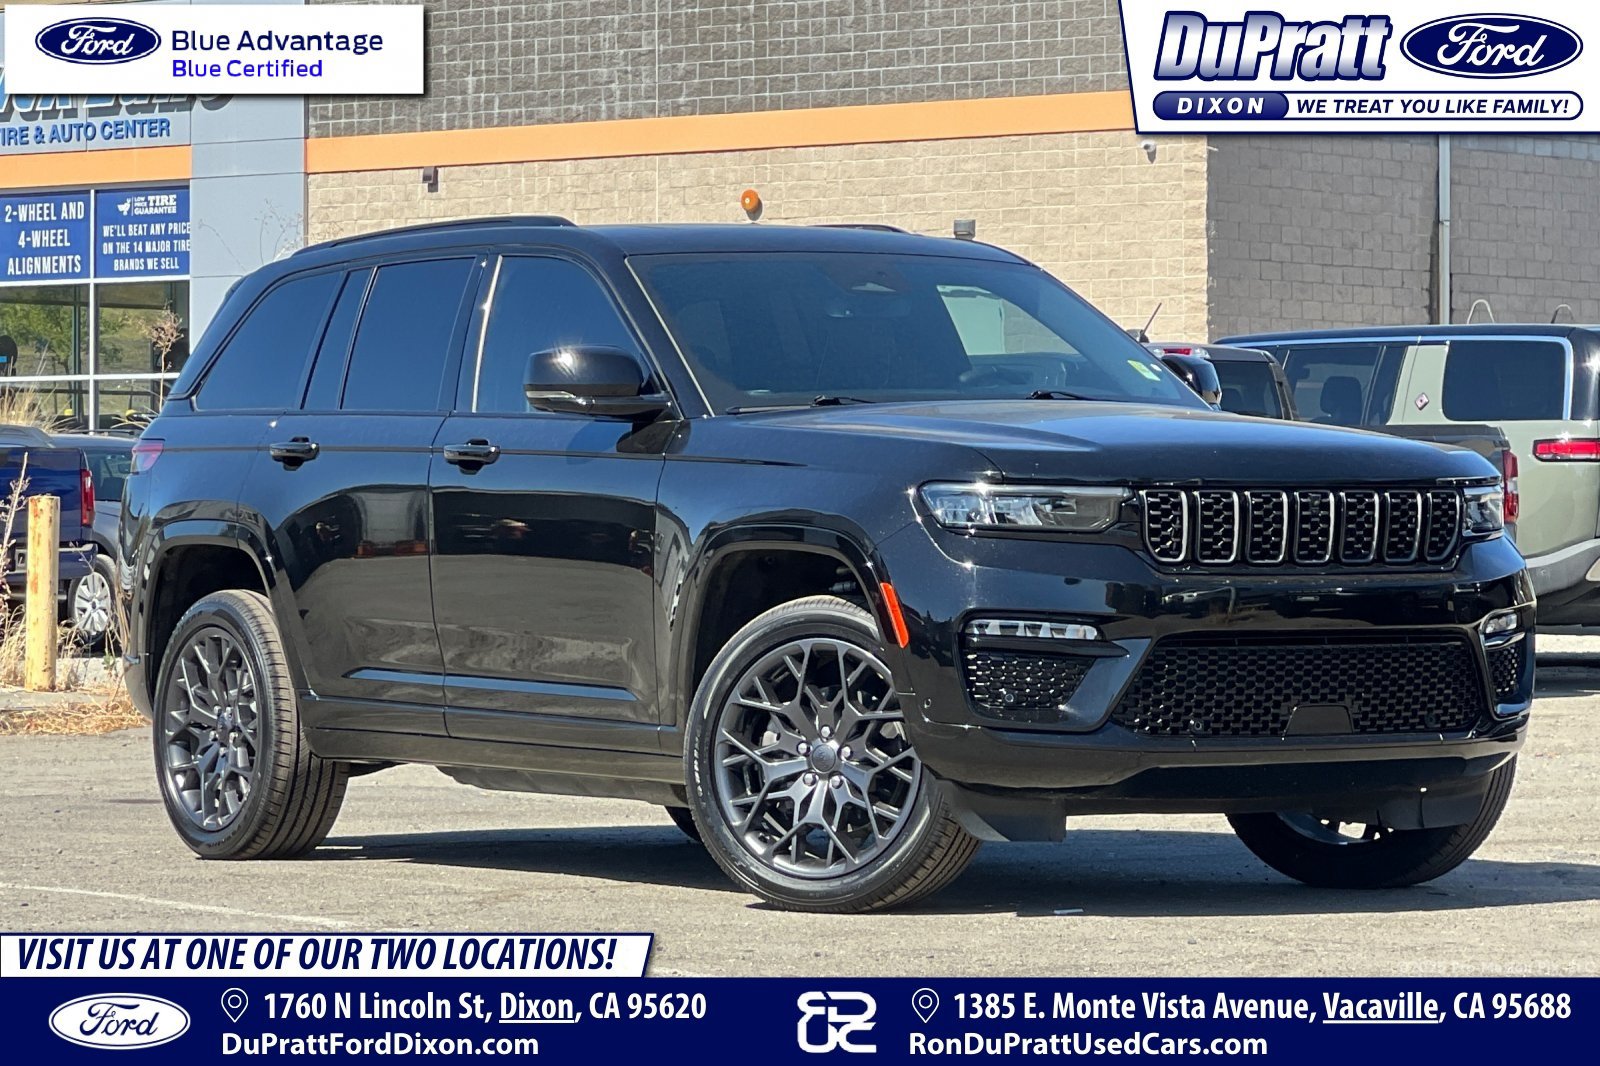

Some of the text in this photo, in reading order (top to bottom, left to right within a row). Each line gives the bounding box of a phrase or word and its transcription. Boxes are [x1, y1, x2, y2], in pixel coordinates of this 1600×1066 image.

[0, 118, 170, 146] IRE & AUTO CENTER
[148, 194, 177, 206] TIRE
[5, 201, 85, 222] 2-WHEEL AND
[134, 206, 177, 215] GUARANTEE
[103, 222, 190, 237] WE'LL BEAT ANY PRICE
[18, 228, 71, 248] 4-WHEEL
[102, 242, 113, 255] ON
[116, 242, 130, 254] THE
[133, 241, 143, 253] 14
[145, 240, 171, 253] MAJOR
[7, 254, 81, 275] ALIGNMENTS
[113, 257, 179, 271] BRANDS WE SELL
